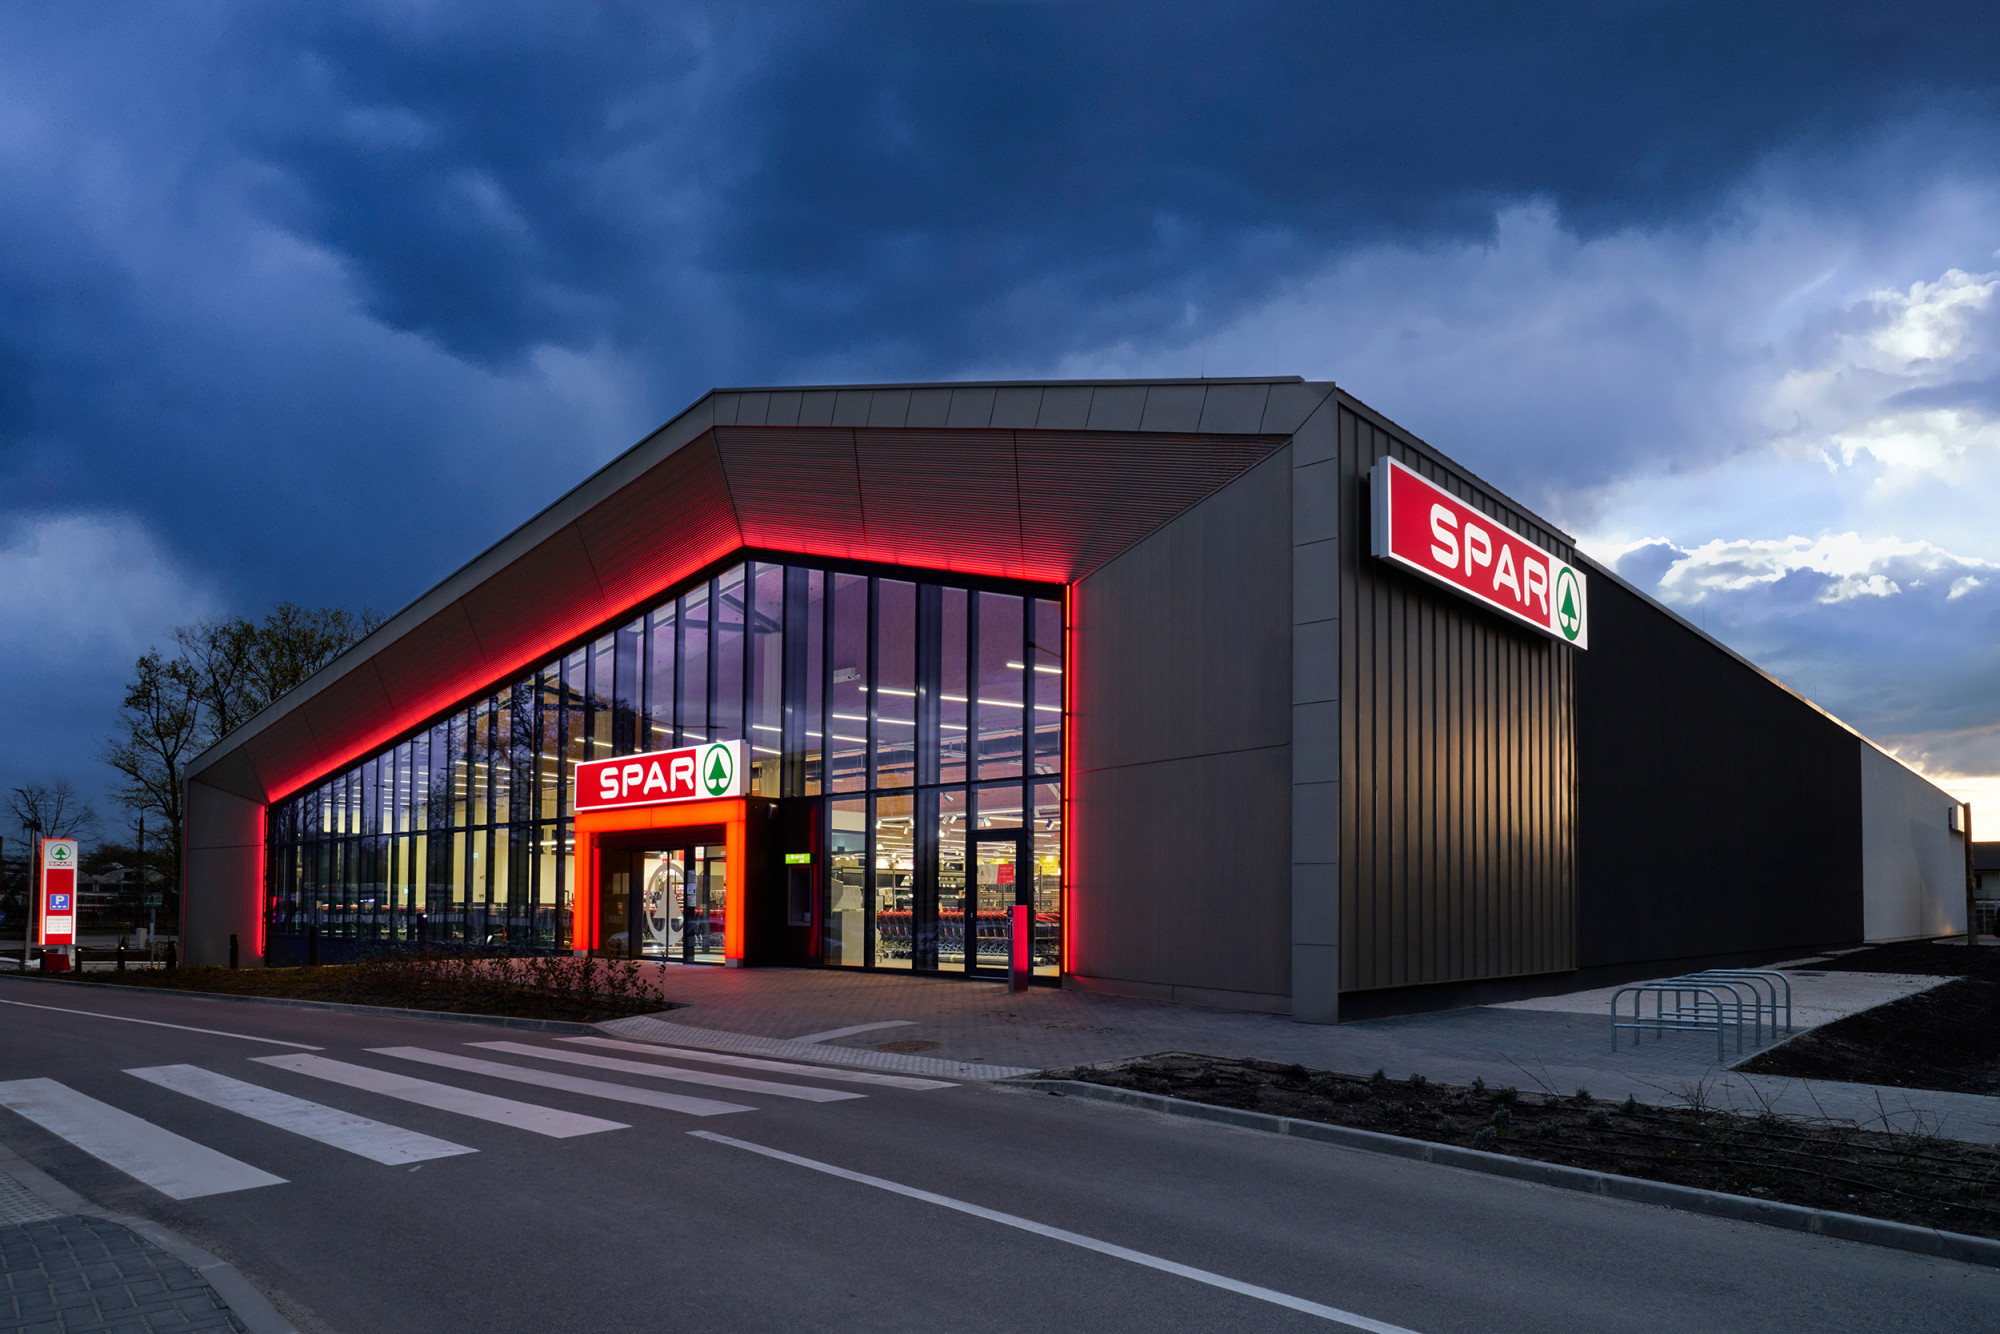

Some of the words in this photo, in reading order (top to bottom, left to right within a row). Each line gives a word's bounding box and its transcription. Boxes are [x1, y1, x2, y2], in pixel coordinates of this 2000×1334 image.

[1430, 503, 1548, 615] SPAR
[600, 757, 694, 799] SPAR
[55, 895, 65, 905] P
